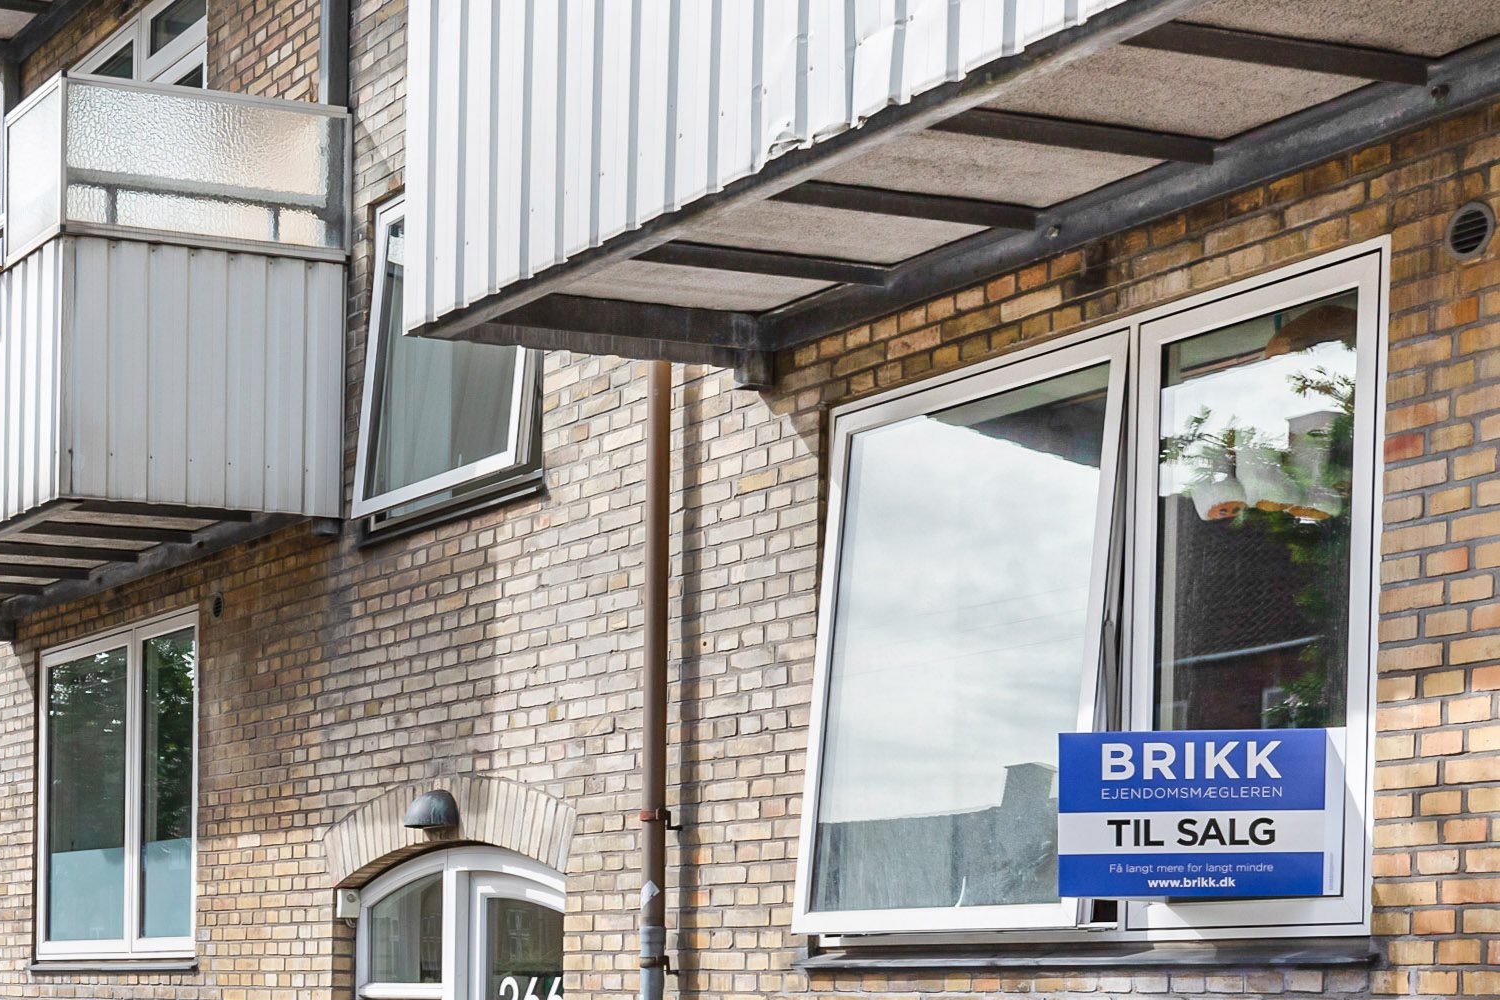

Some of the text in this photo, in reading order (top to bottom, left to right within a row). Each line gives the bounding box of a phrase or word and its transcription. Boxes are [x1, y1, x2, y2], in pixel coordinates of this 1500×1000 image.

[1101, 740, 1283, 781] BRIKK
[1101, 785, 1283, 800] EJENDOMSMÆGLEREN
[1107, 817, 1276, 847] TIL SALG
[1109, 862, 1274, 875] Få langt mere for langt mindre
[1147, 876, 1236, 888] www.brikk.dk
